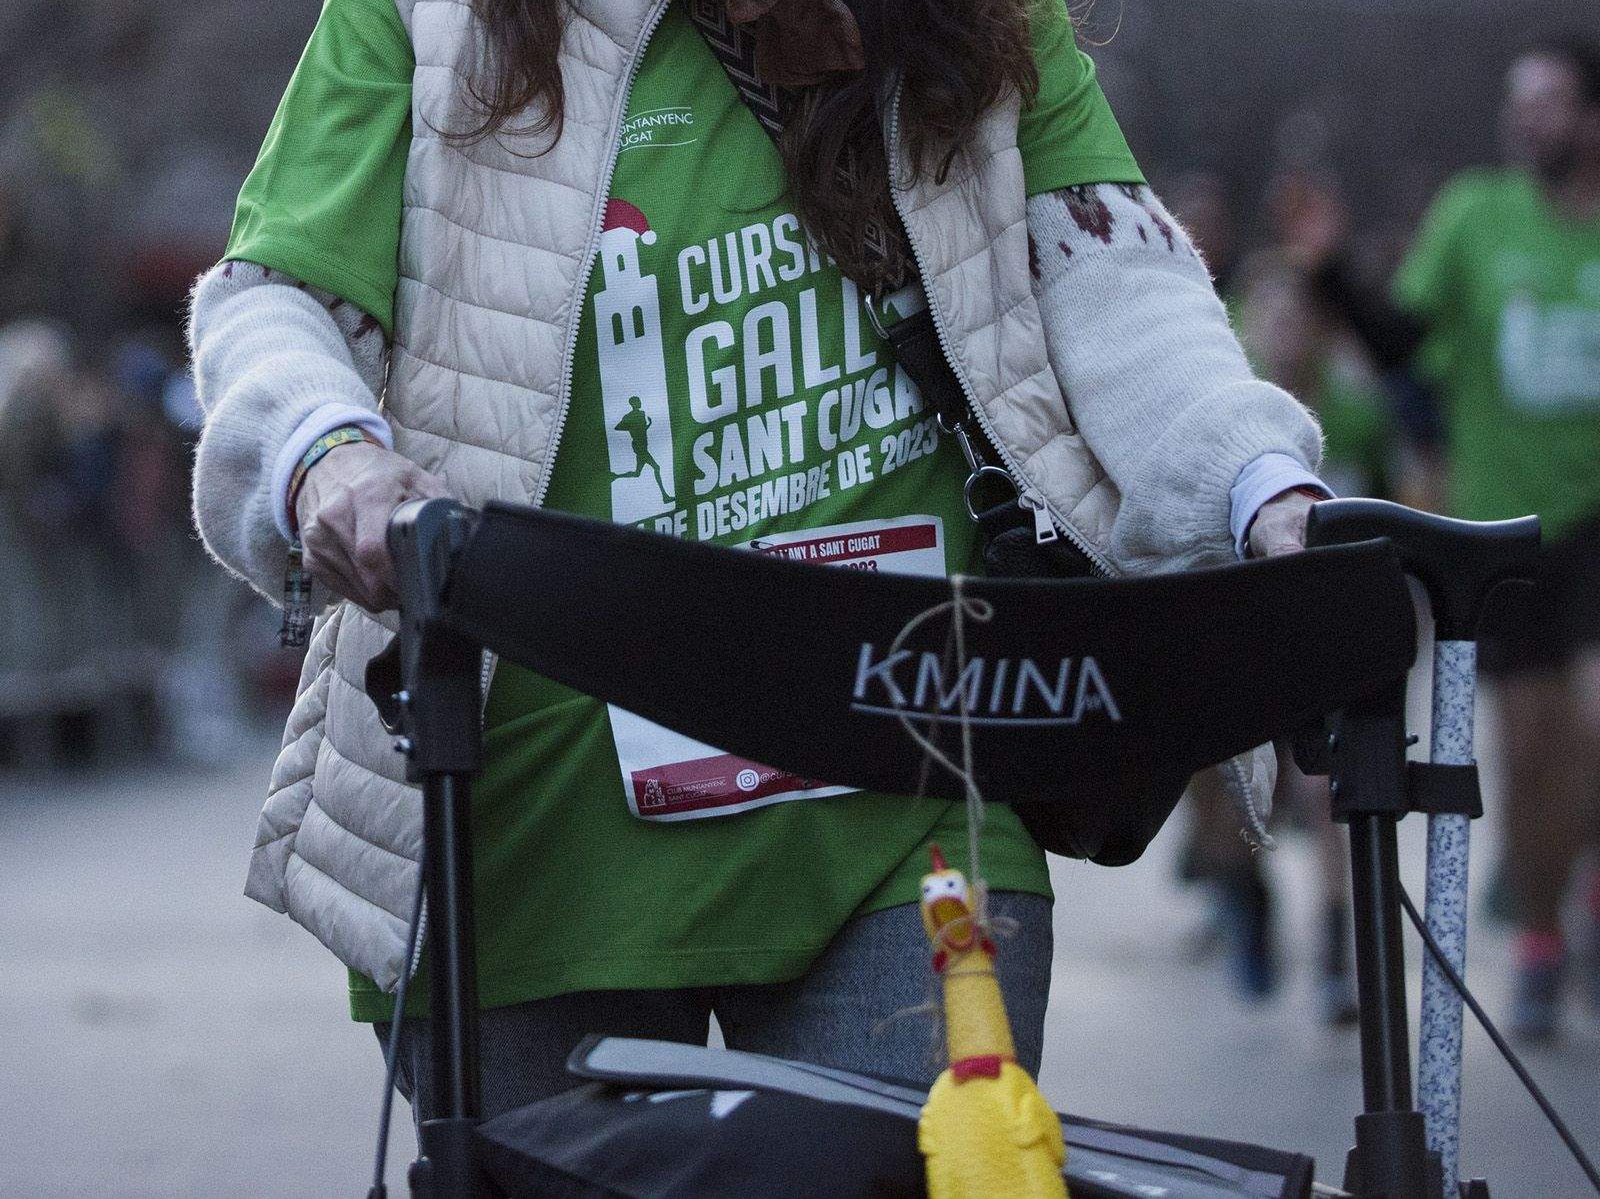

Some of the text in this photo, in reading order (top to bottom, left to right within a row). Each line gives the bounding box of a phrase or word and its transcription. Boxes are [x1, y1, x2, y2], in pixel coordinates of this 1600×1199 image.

[619, 130, 653, 147] UGAT
[677, 213, 836, 315] CURS
[692, 362, 929, 495] SANT CUGA
[696, 460, 832, 541] DESEMBRE
[838, 443, 875, 491] DE
[880, 416, 939, 476] 2023
[810, 544, 818, 559] A
[819, 540, 845, 557] SANT
[848, 535, 881, 553] CUGAT
[852, 642, 1122, 724] KMINA
